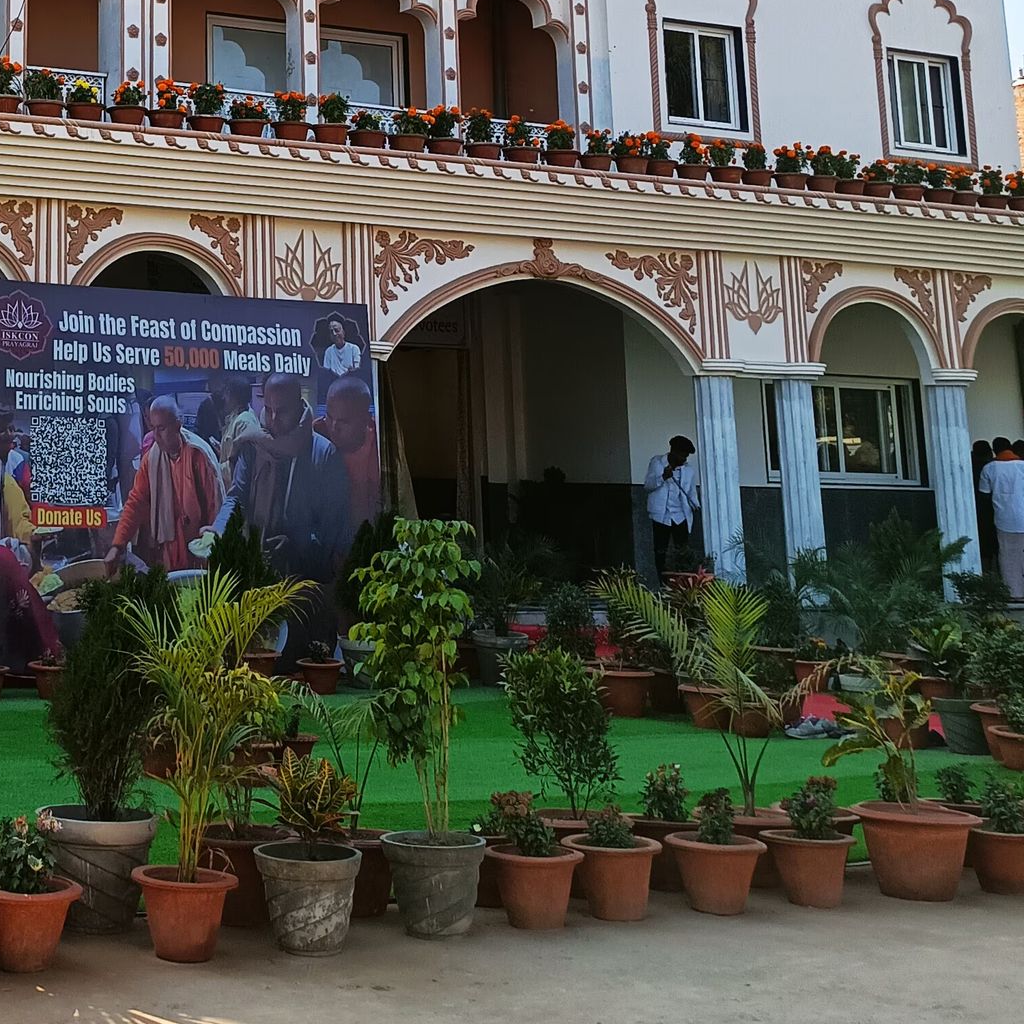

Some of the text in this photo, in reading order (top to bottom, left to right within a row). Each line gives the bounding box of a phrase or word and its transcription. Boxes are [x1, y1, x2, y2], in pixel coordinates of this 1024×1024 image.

[2, 331, 39, 340] ISKCON
[58, 310, 302, 347] Join the Feast of Compassion
[419, 320, 458, 333] votees
[2, 340, 39, 348] PRAYAGRAJ
[53, 339, 311, 377] Help Us Serve 50,000 Meals Daily
[5, 369, 135, 394] Nourishing Bodies
[15, 390, 126, 414] Enriching Souls
[37, 507, 102, 526] Donate Us
